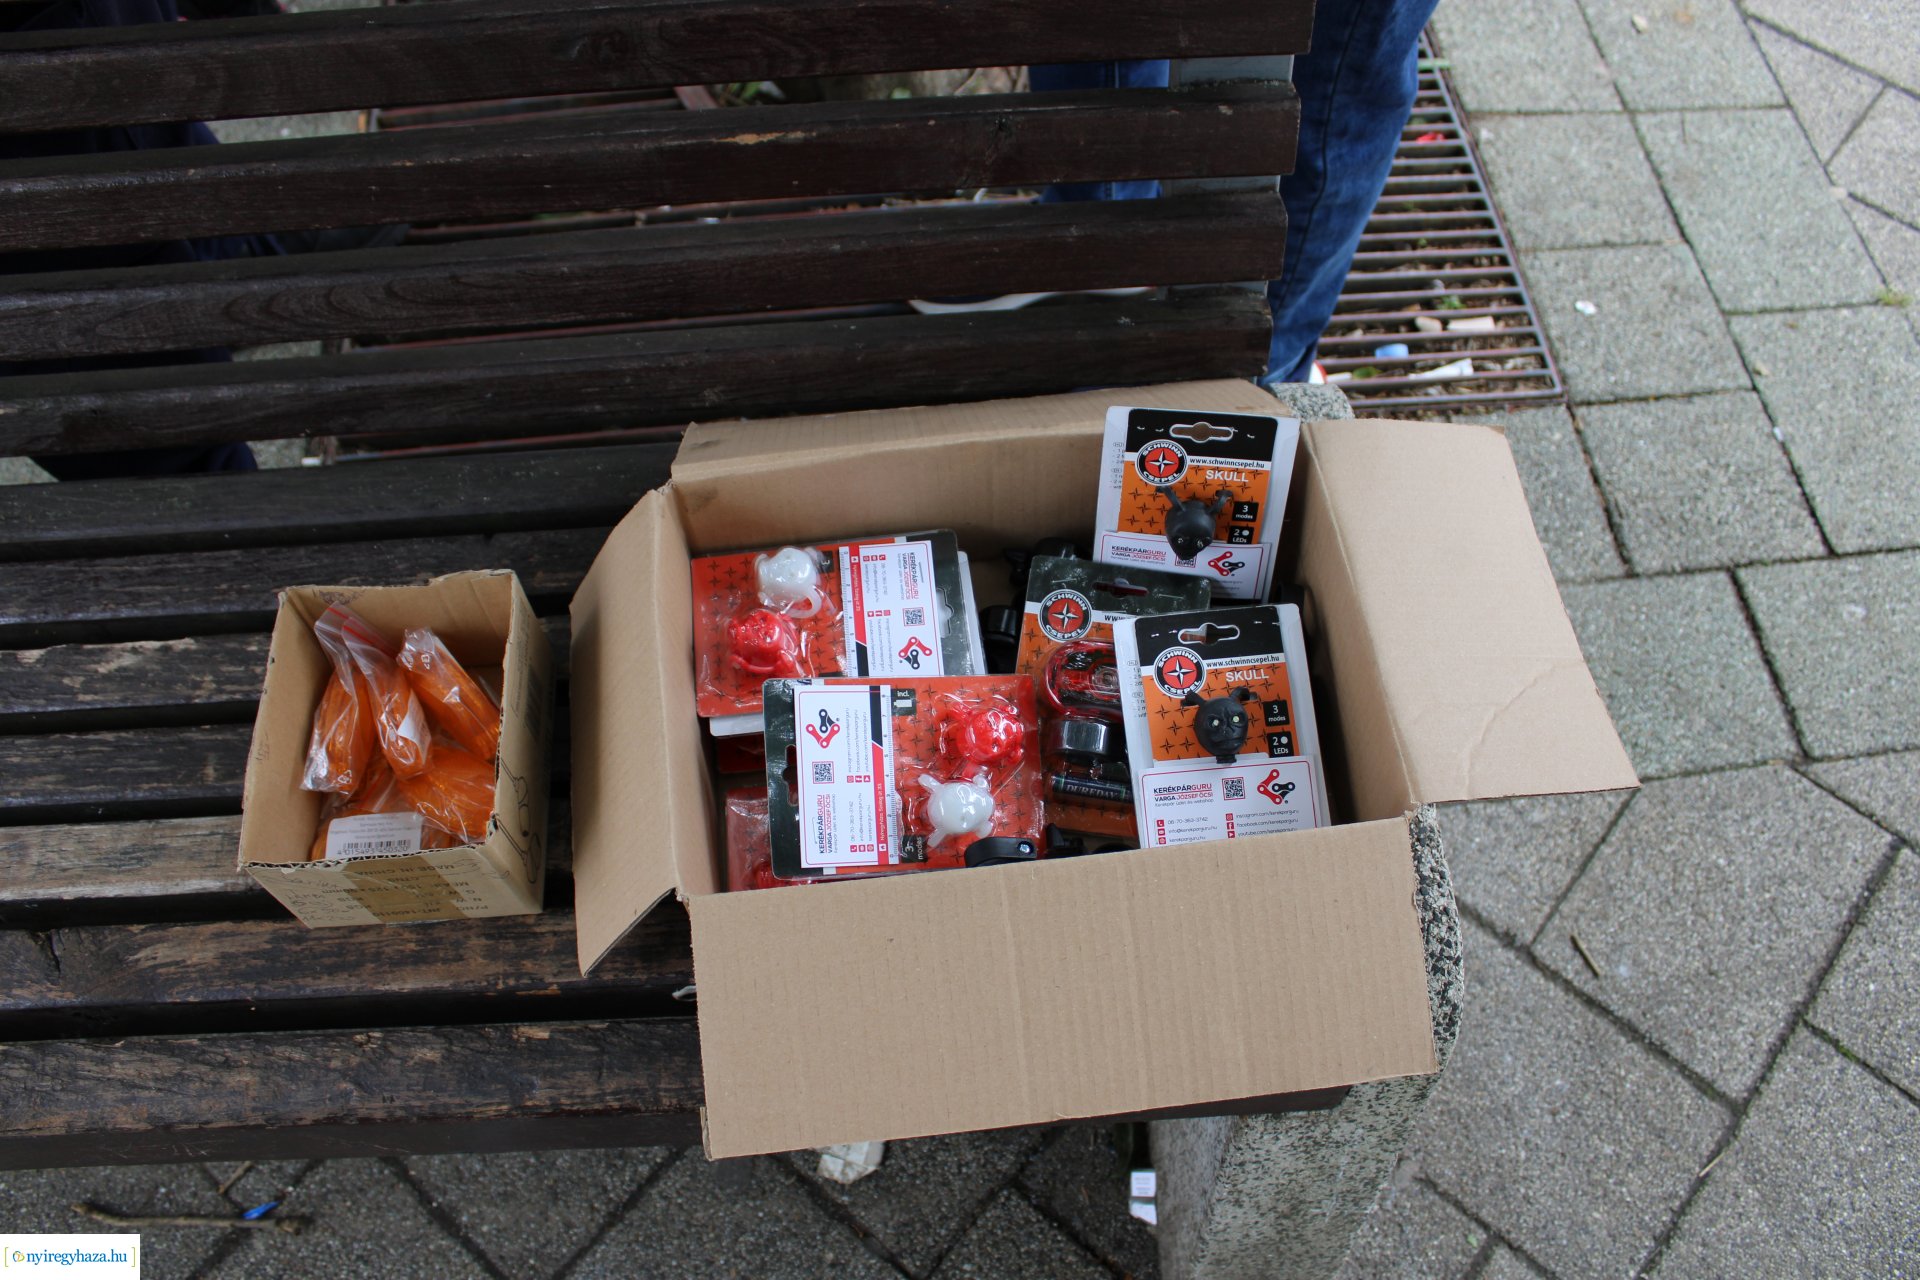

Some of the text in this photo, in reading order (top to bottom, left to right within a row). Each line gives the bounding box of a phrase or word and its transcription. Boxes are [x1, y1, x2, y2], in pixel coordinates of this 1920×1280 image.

[1142, 443, 1182, 458] SCHWINN
[1189, 457, 1266, 469] www.schwinncsepel.hu
[1143, 471, 1180, 484] CSEPEL
[1205, 470, 1249, 482] SKULL
[1243, 504, 1248, 512] 3
[1046, 592, 1087, 612] SCHWINN
[1046, 624, 1084, 640] CSEPEL
[1158, 651, 1198, 668] SCHWINN
[1206, 655, 1280, 668] www.schwinncsepel.hu
[1226, 668, 1270, 682] SKULL
[1164, 680, 1201, 694] CSEPEL
[1272, 706, 1279, 714] 3
[1272, 736, 1279, 746] 2
[1274, 746, 1288, 754] LEDs
[1154, 784, 1212, 794] KERÉKPÁRGURU
